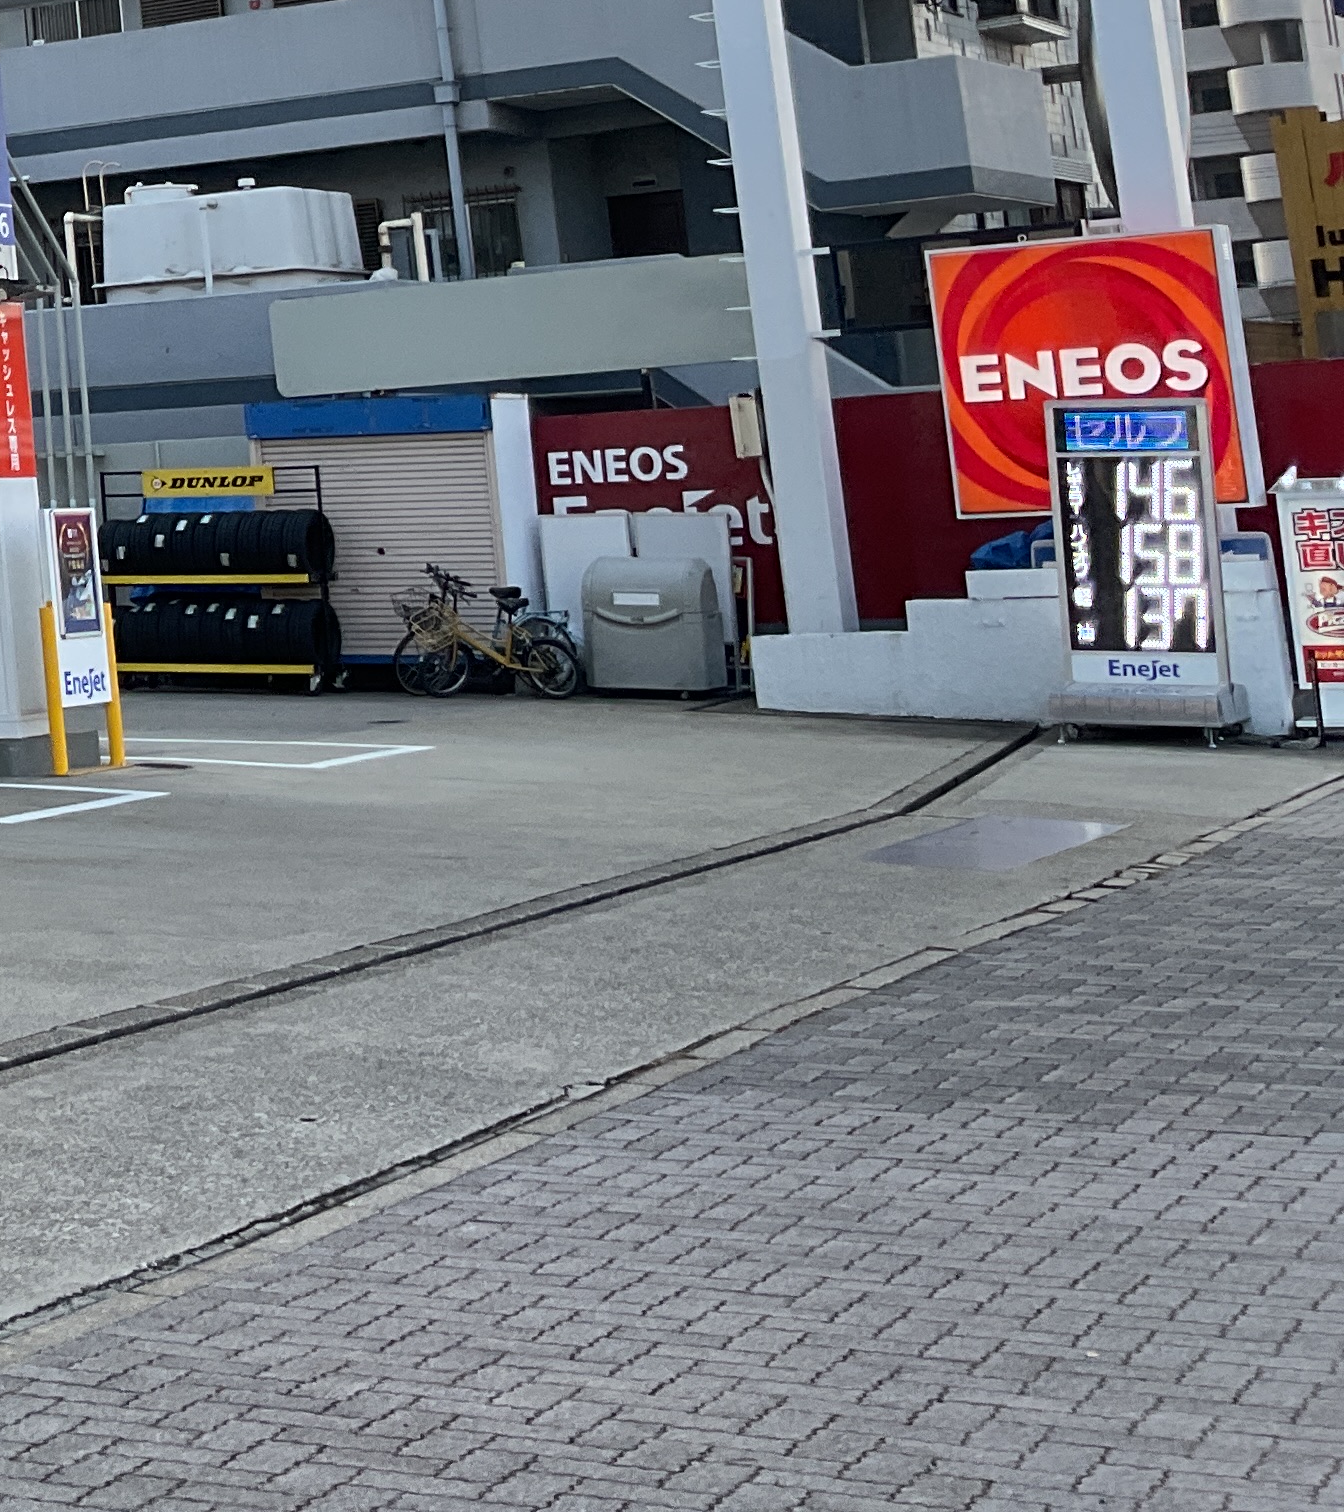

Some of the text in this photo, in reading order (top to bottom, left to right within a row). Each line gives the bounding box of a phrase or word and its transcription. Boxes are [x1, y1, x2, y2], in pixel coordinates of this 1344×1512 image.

[0, 213, 10, 238] 6
[960, 339, 1208, 403] ENEOS
[1067, 414, 1182, 448] セルフ
[168, 475, 263, 489] DUNLOP
[547, 444, 688, 485] ENEOS
[1116, 459, 1197, 521] 146
[1119, 523, 1204, 586] 158
[1124, 585, 1210, 650] 137
[64, 668, 106, 699] Enejet
[1107, 659, 1180, 681] Enejet
